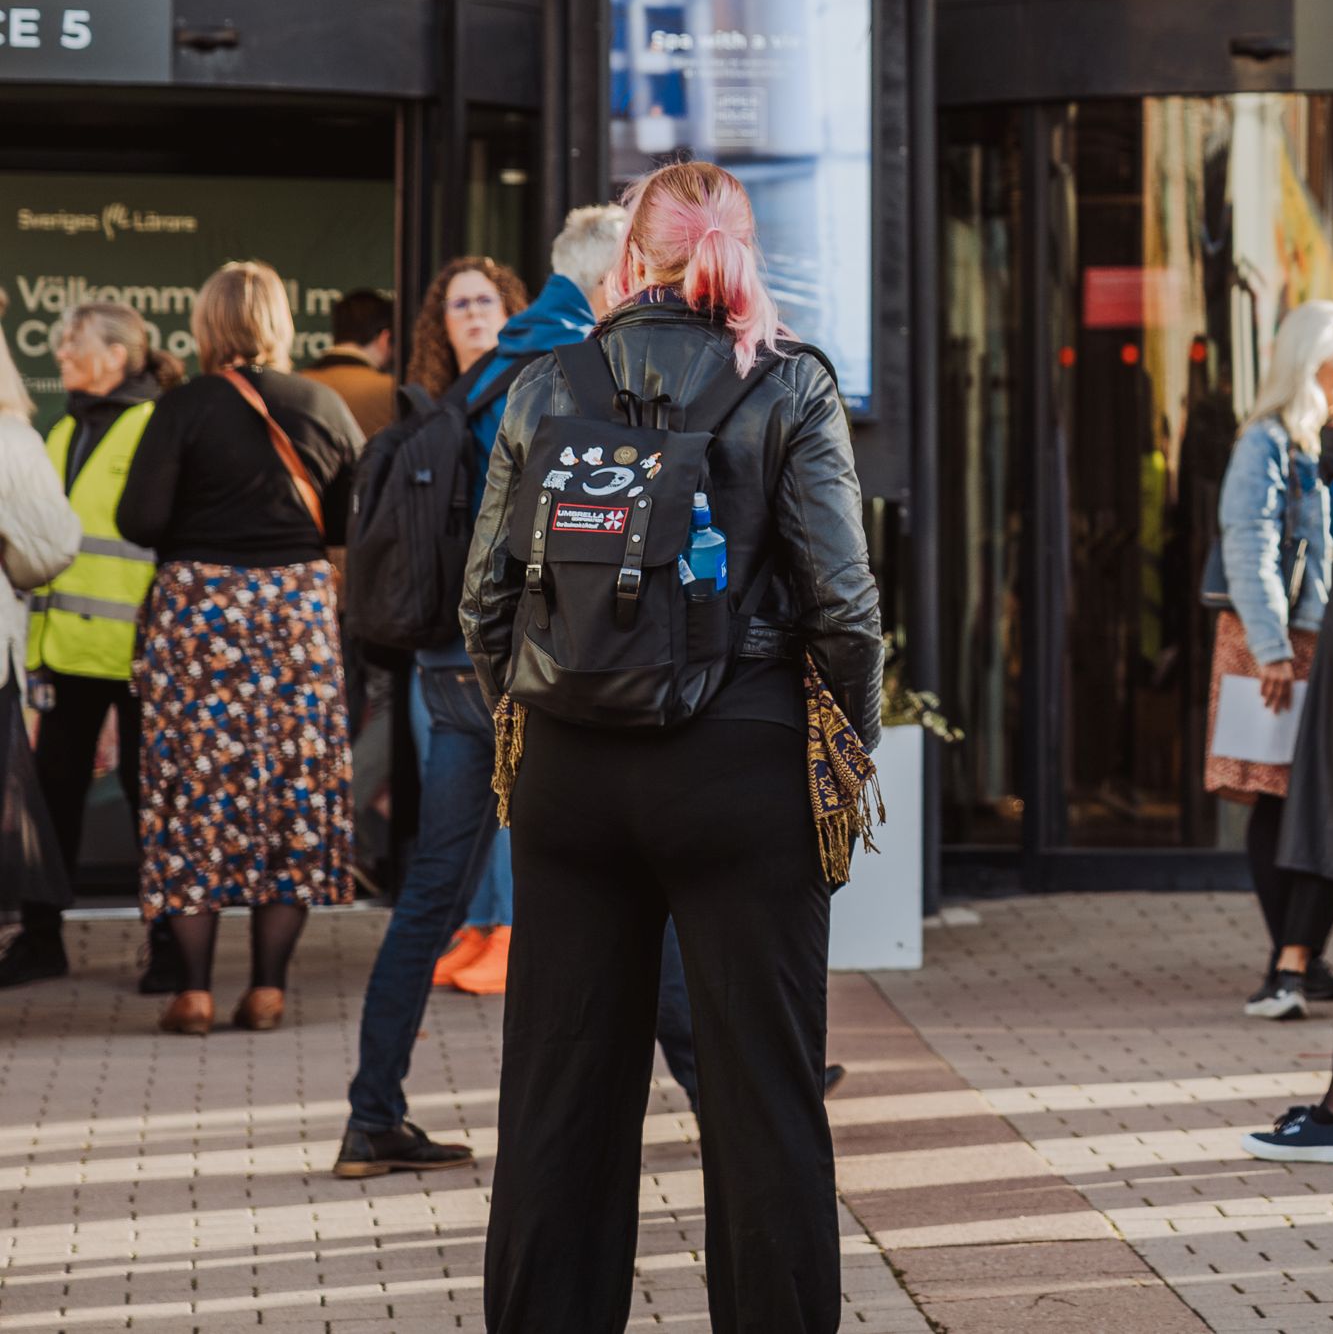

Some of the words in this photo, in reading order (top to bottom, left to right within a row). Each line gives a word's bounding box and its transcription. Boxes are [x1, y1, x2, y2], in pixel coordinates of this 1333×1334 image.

[60, 9, 92, 50] 5
[651, 30, 693, 52] Spa
[557, 510, 604, 519] UMBRELLA
